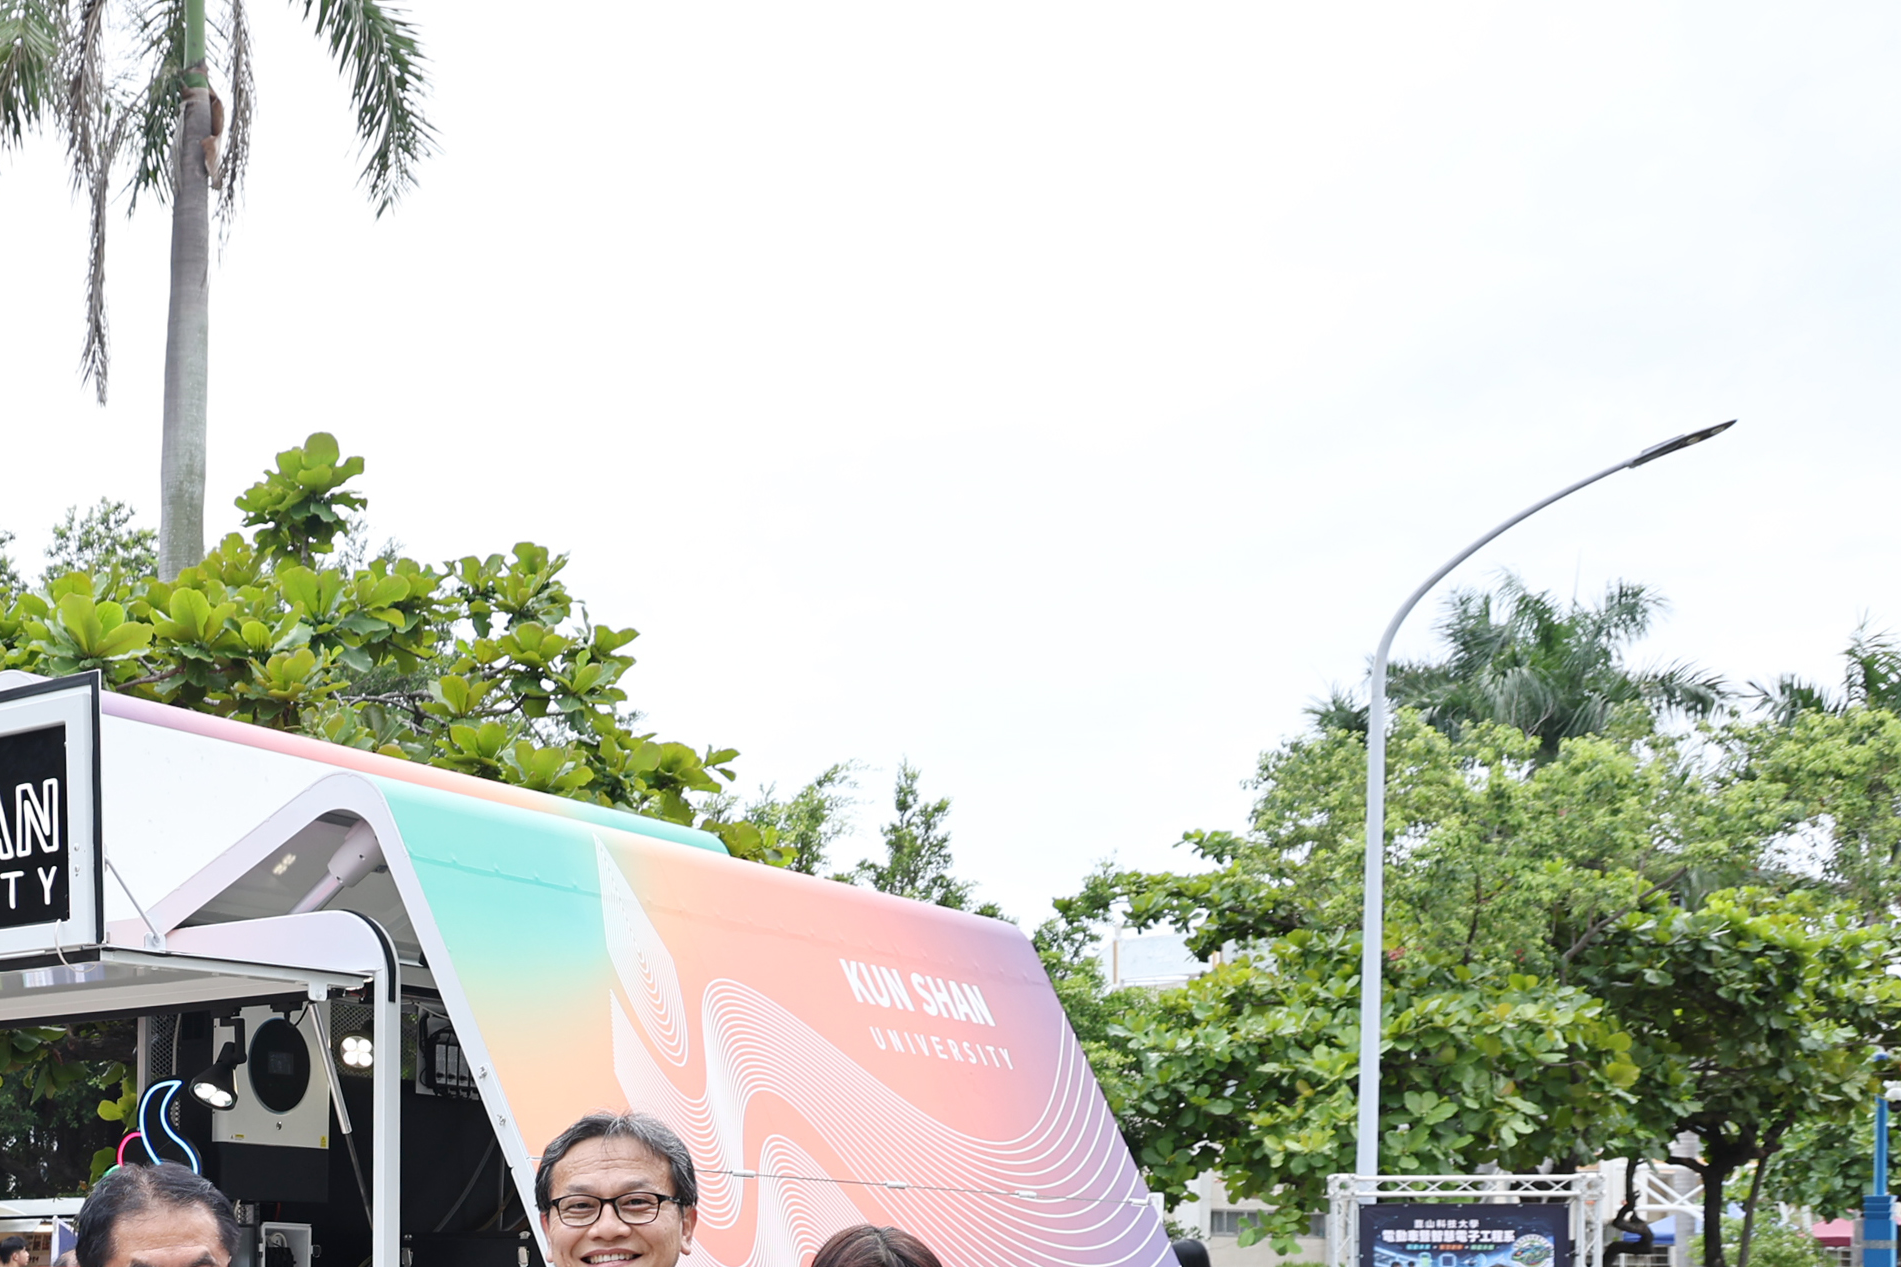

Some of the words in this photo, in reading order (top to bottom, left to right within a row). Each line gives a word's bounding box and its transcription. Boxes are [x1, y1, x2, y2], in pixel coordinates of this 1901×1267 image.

[839, 958, 915, 1012] KUN
[910, 972, 996, 1027] SHAN
[869, 1026, 1014, 1070] UNIVERSITY
[1382, 1230, 1516, 1244] 電動車暨智慧電子工程系
